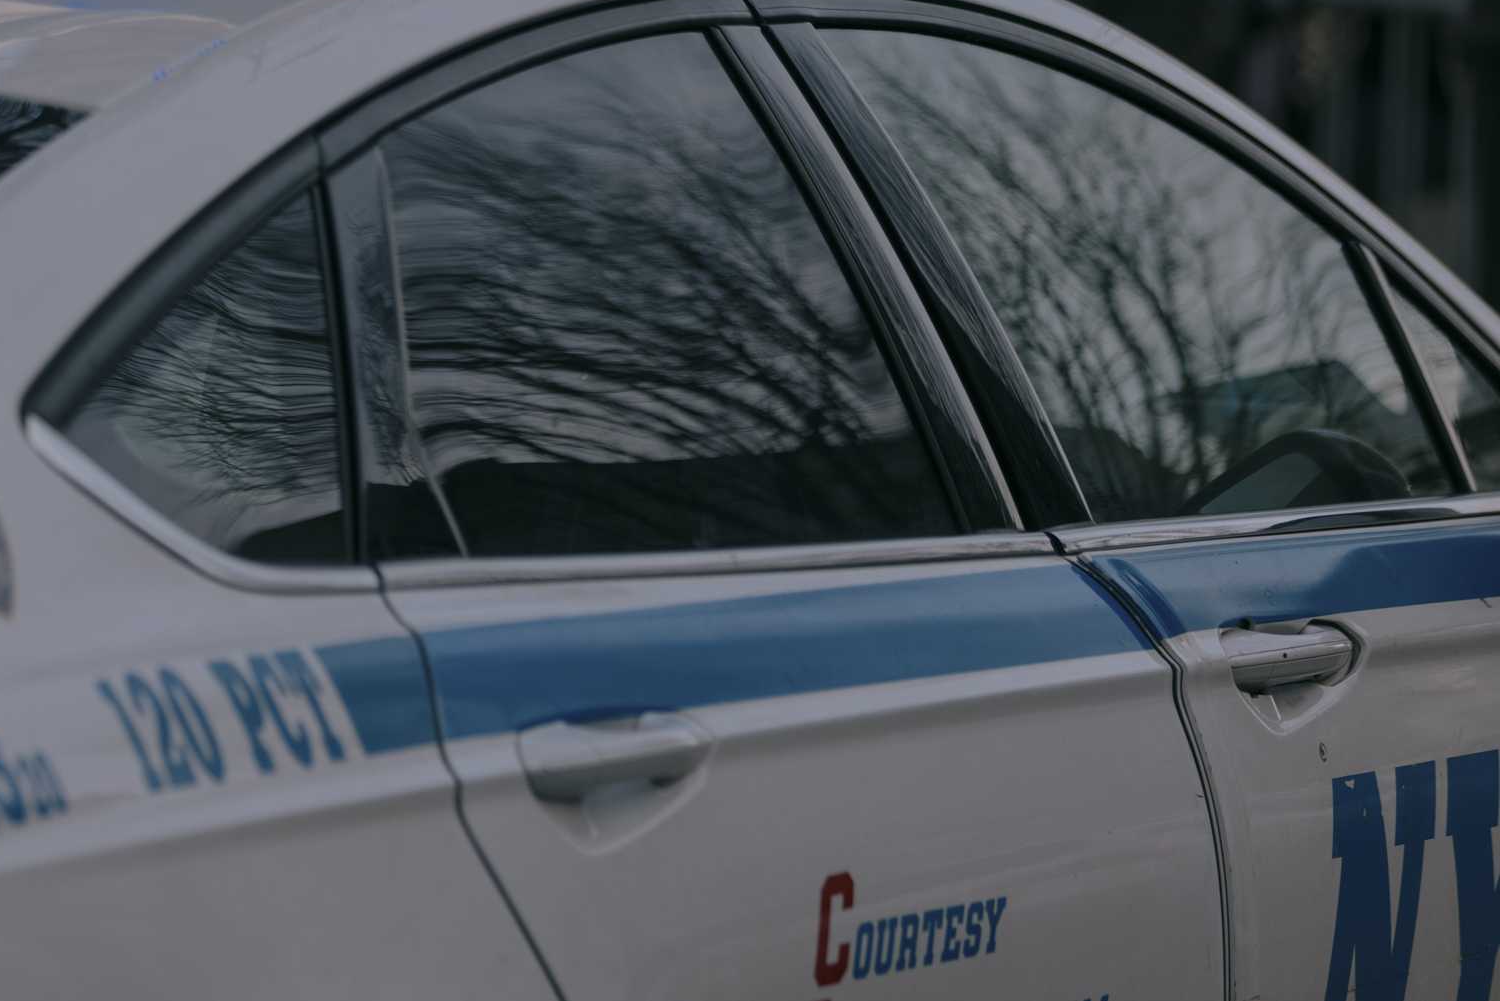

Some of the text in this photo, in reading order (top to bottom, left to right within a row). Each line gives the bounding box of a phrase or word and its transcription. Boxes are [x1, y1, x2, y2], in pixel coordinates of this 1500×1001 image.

[95, 668, 224, 793] 120
[206, 650, 346, 774] PCT
[814, 871, 1007, 988] COURTESY
